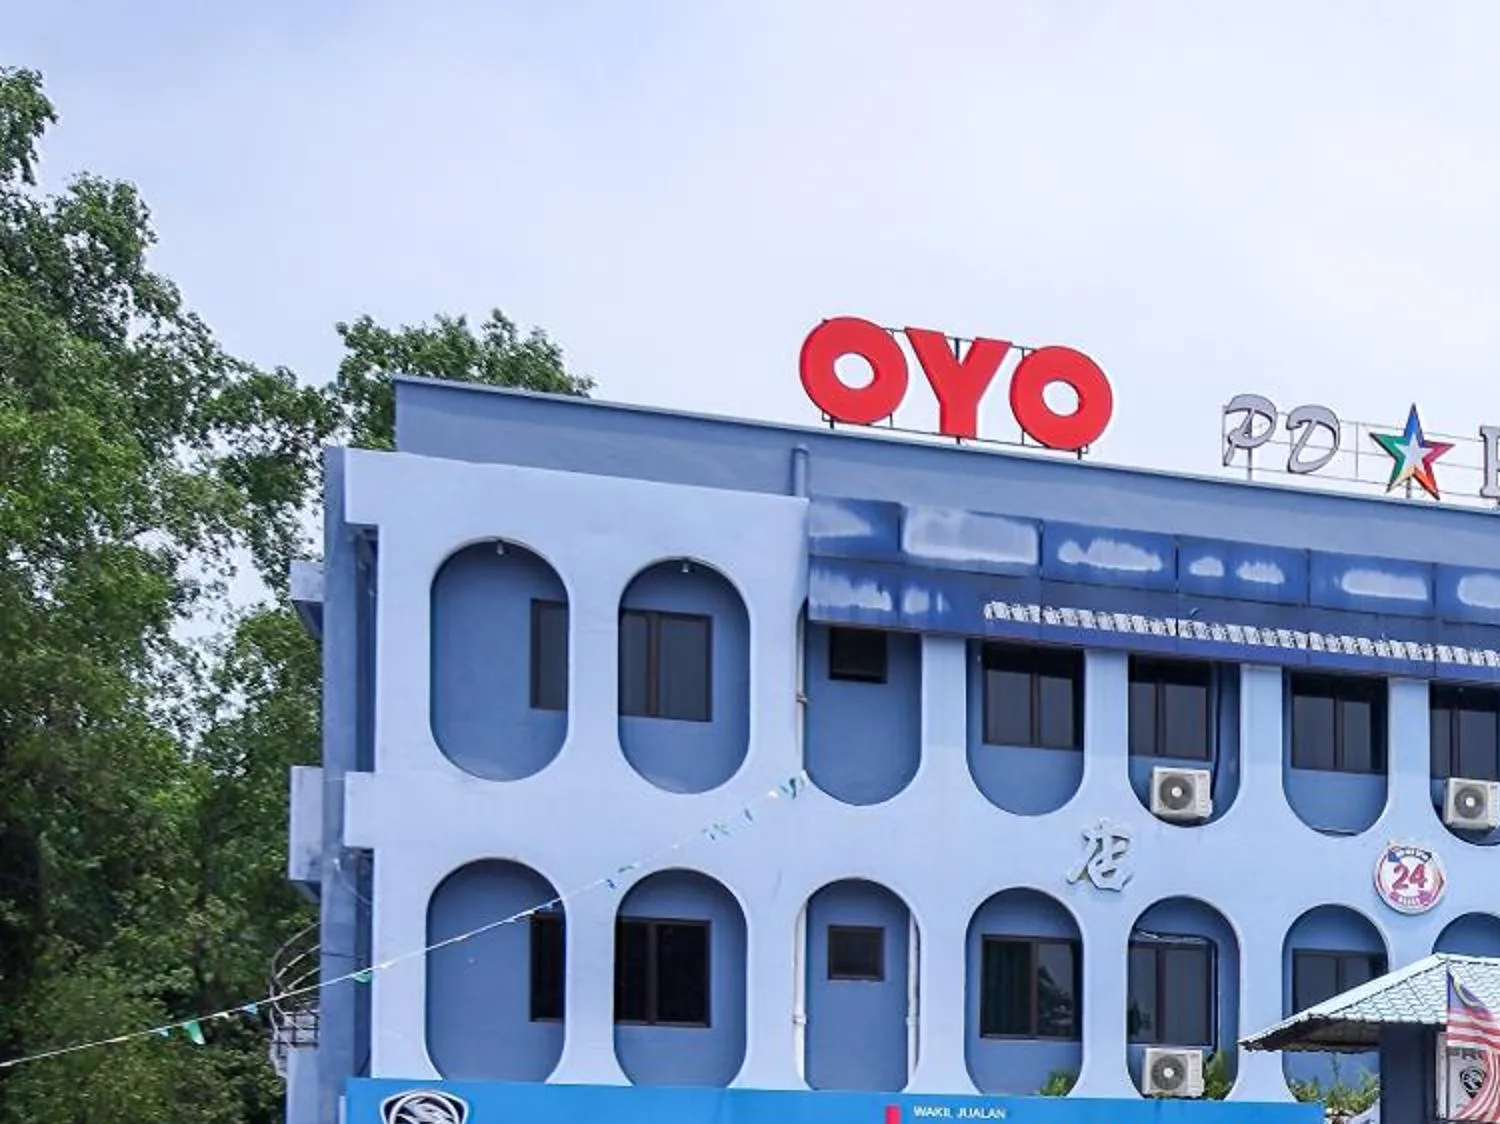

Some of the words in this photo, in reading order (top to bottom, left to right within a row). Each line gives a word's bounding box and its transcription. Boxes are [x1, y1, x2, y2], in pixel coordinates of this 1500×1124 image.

[799, 316, 1114, 451] OYO
[1223, 394, 1341, 475] PD
[1392, 863, 1425, 890] 24
[914, 1105, 952, 1119] WAKIL
[957, 1107, 1006, 1120] JUALAN
